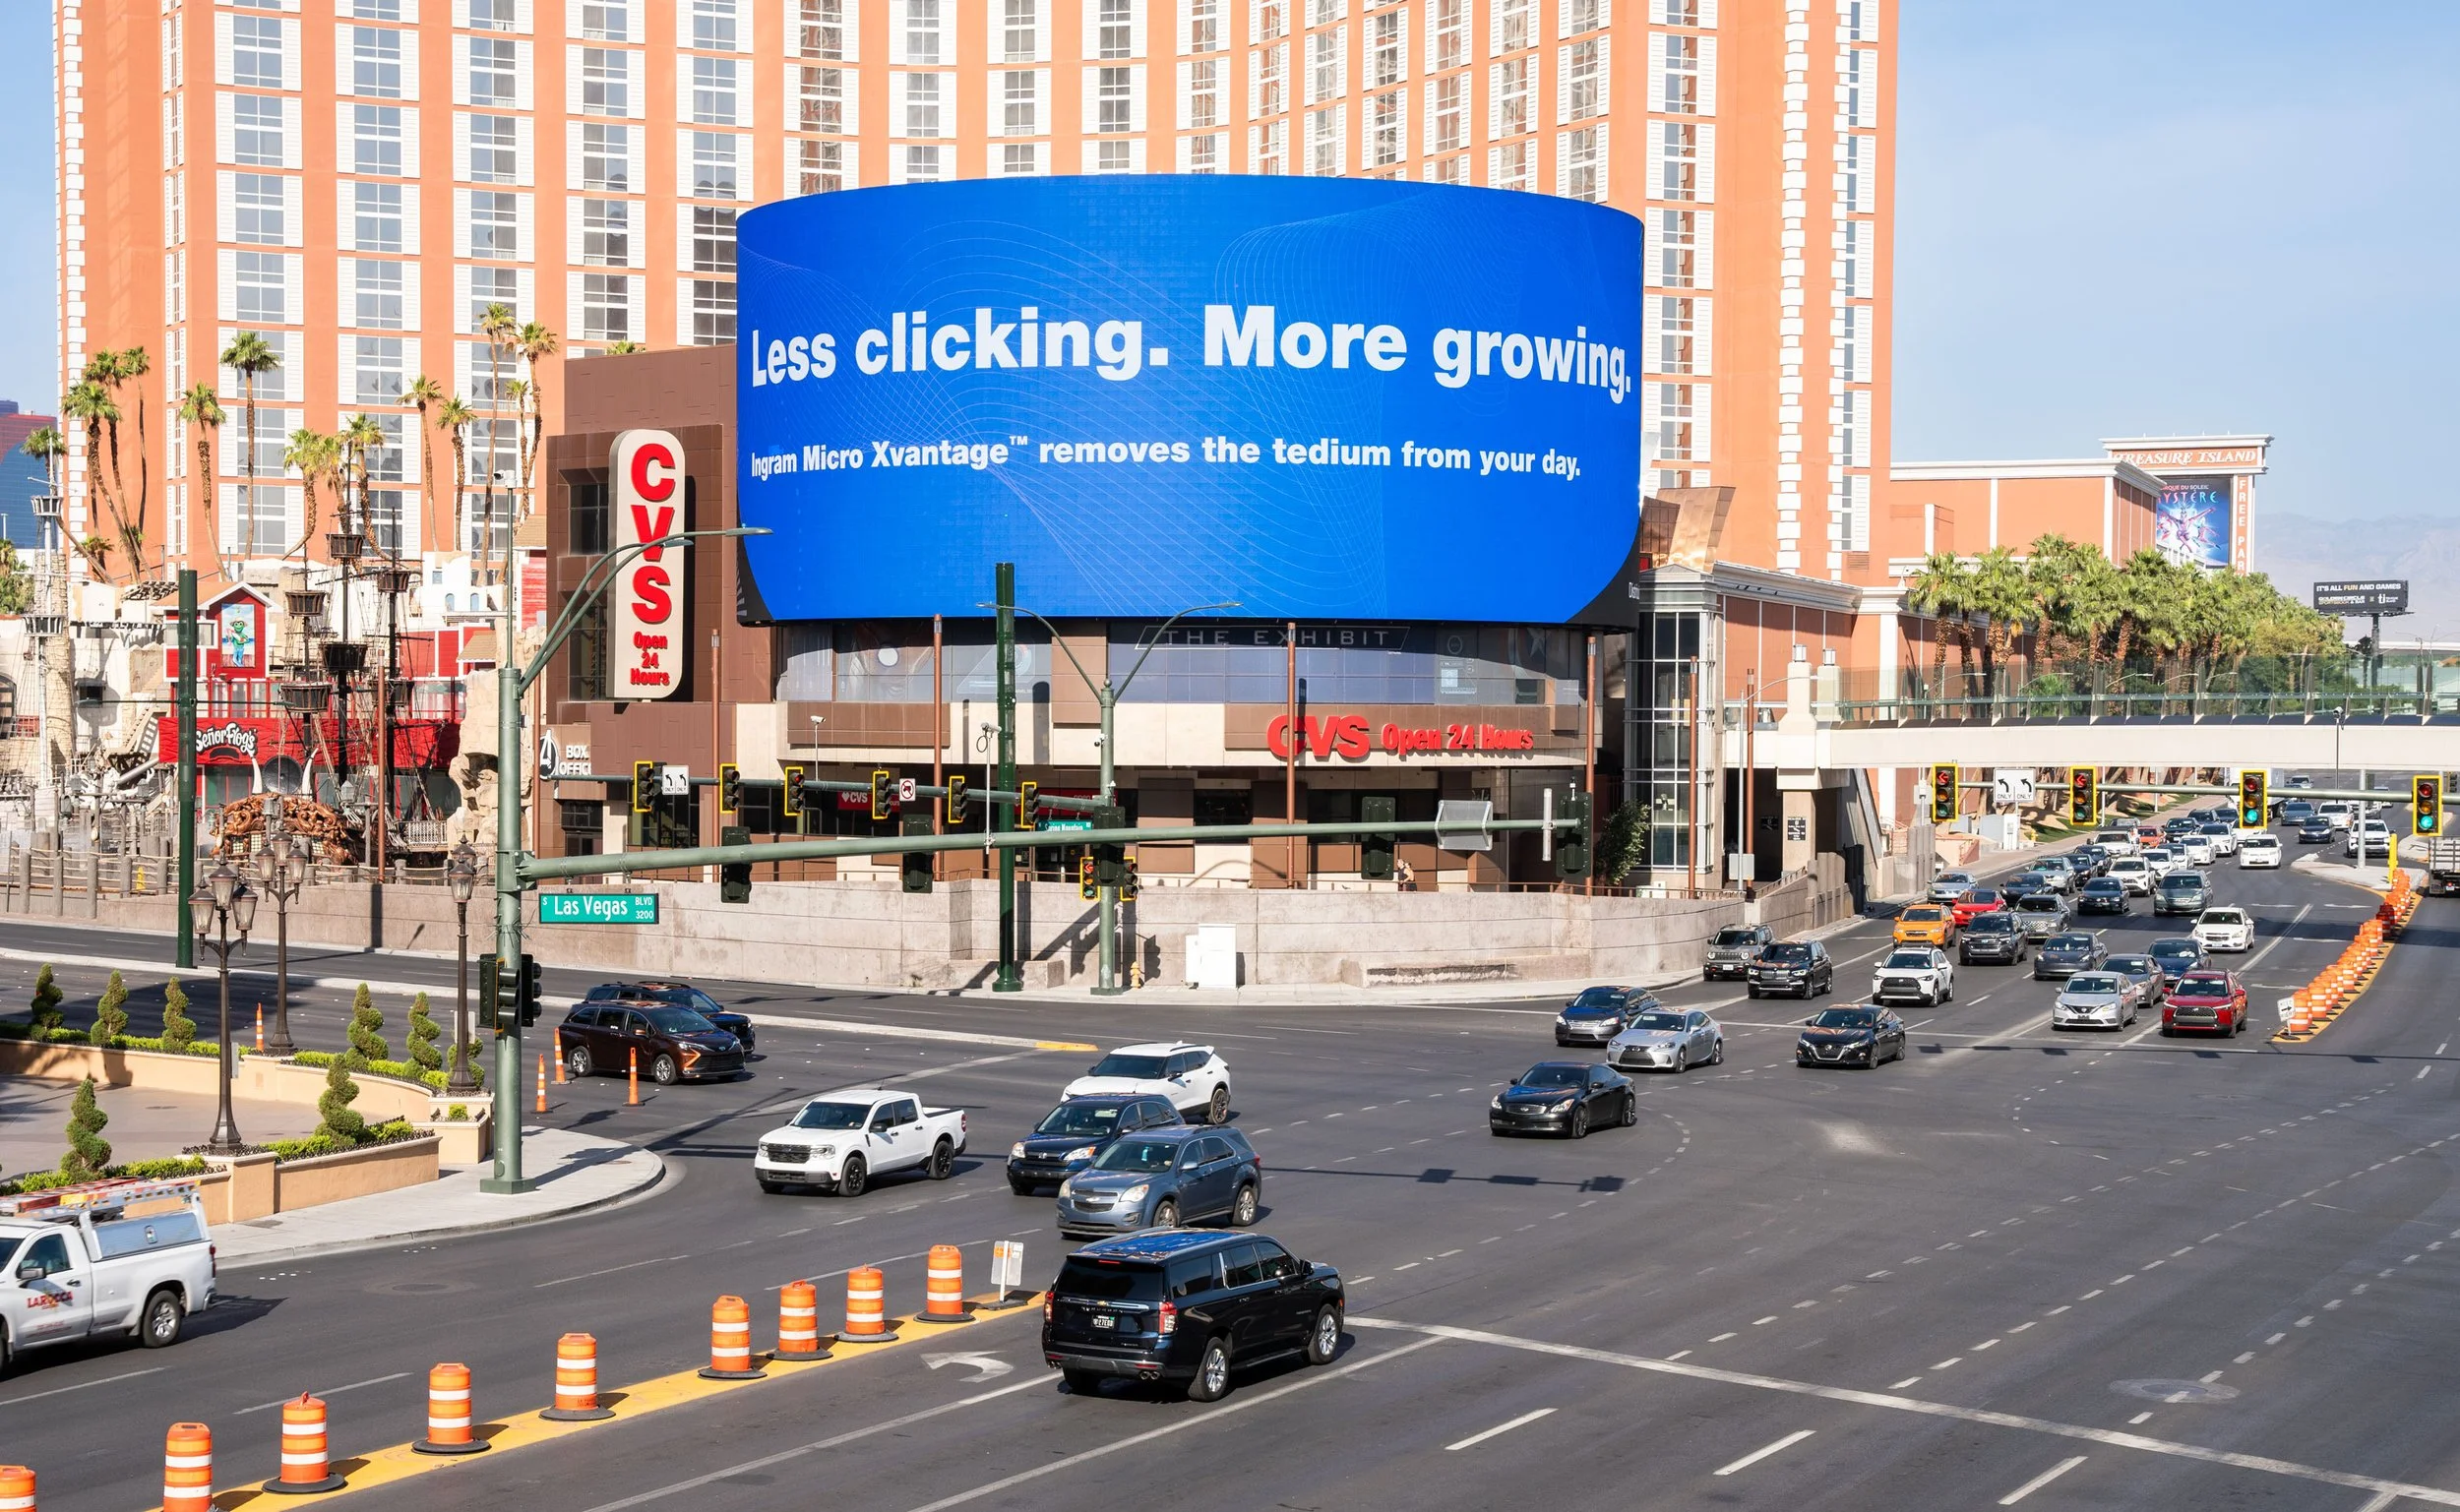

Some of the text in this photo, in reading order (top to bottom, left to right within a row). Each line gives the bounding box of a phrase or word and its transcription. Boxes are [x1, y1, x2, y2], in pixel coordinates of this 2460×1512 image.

[752, 304, 1631, 404] Less clicking. More growing.
[751, 451, 797, 481] Ingram
[803, 445, 863, 472] Micro
[1039, 440, 1190, 464] removes
[1201, 436, 1261, 463] the
[1272, 438, 1390, 466] tedium
[1401, 440, 1471, 469] from
[1479, 449, 1535, 476] your
[1542, 448, 1581, 481] day.
[2197, 451, 2256, 463] ISLAND
[631, 443, 676, 625] CVS
[634, 631, 668, 651] Open
[1163, 631, 1229, 645] THE
[642, 651, 659, 669] 24
[631, 668, 670, 686] Hours
[1266, 715, 1534, 758] CVS Open 24 Hours
[566, 745, 590, 759] BOX
[850, 792, 868, 803] CVS
[542, 895, 652, 921] S Las Vegas BLVD
[636, 910, 653, 919] 3200
